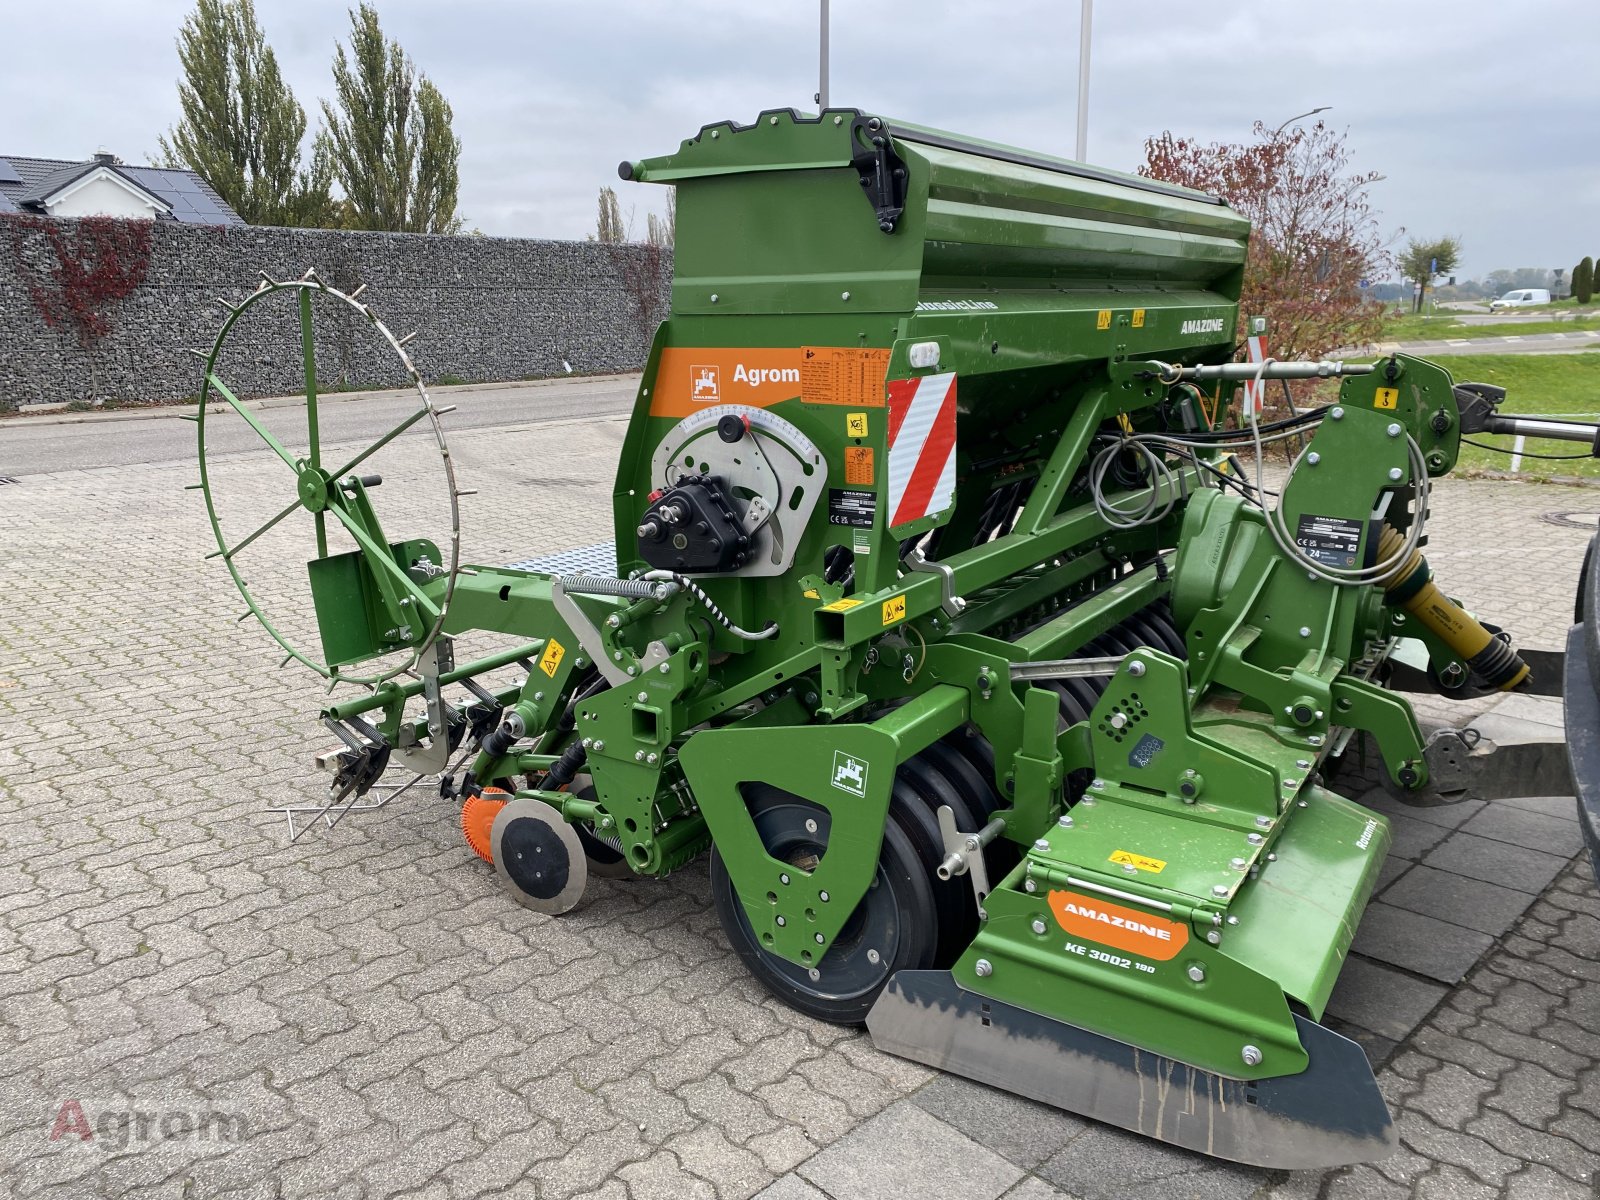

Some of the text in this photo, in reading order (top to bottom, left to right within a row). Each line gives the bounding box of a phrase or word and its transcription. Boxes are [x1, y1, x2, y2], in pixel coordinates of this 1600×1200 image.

[1180, 318, 1224, 335] AMAZONE
[733, 364, 800, 387] Agrom
[842, 490, 872, 498] AMAZONE
[1309, 549, 1321, 558] 24
[1064, 903, 1171, 941] AMAZONE
[1064, 942, 1087, 956] KE
[1088, 949, 1132, 969] 3002
